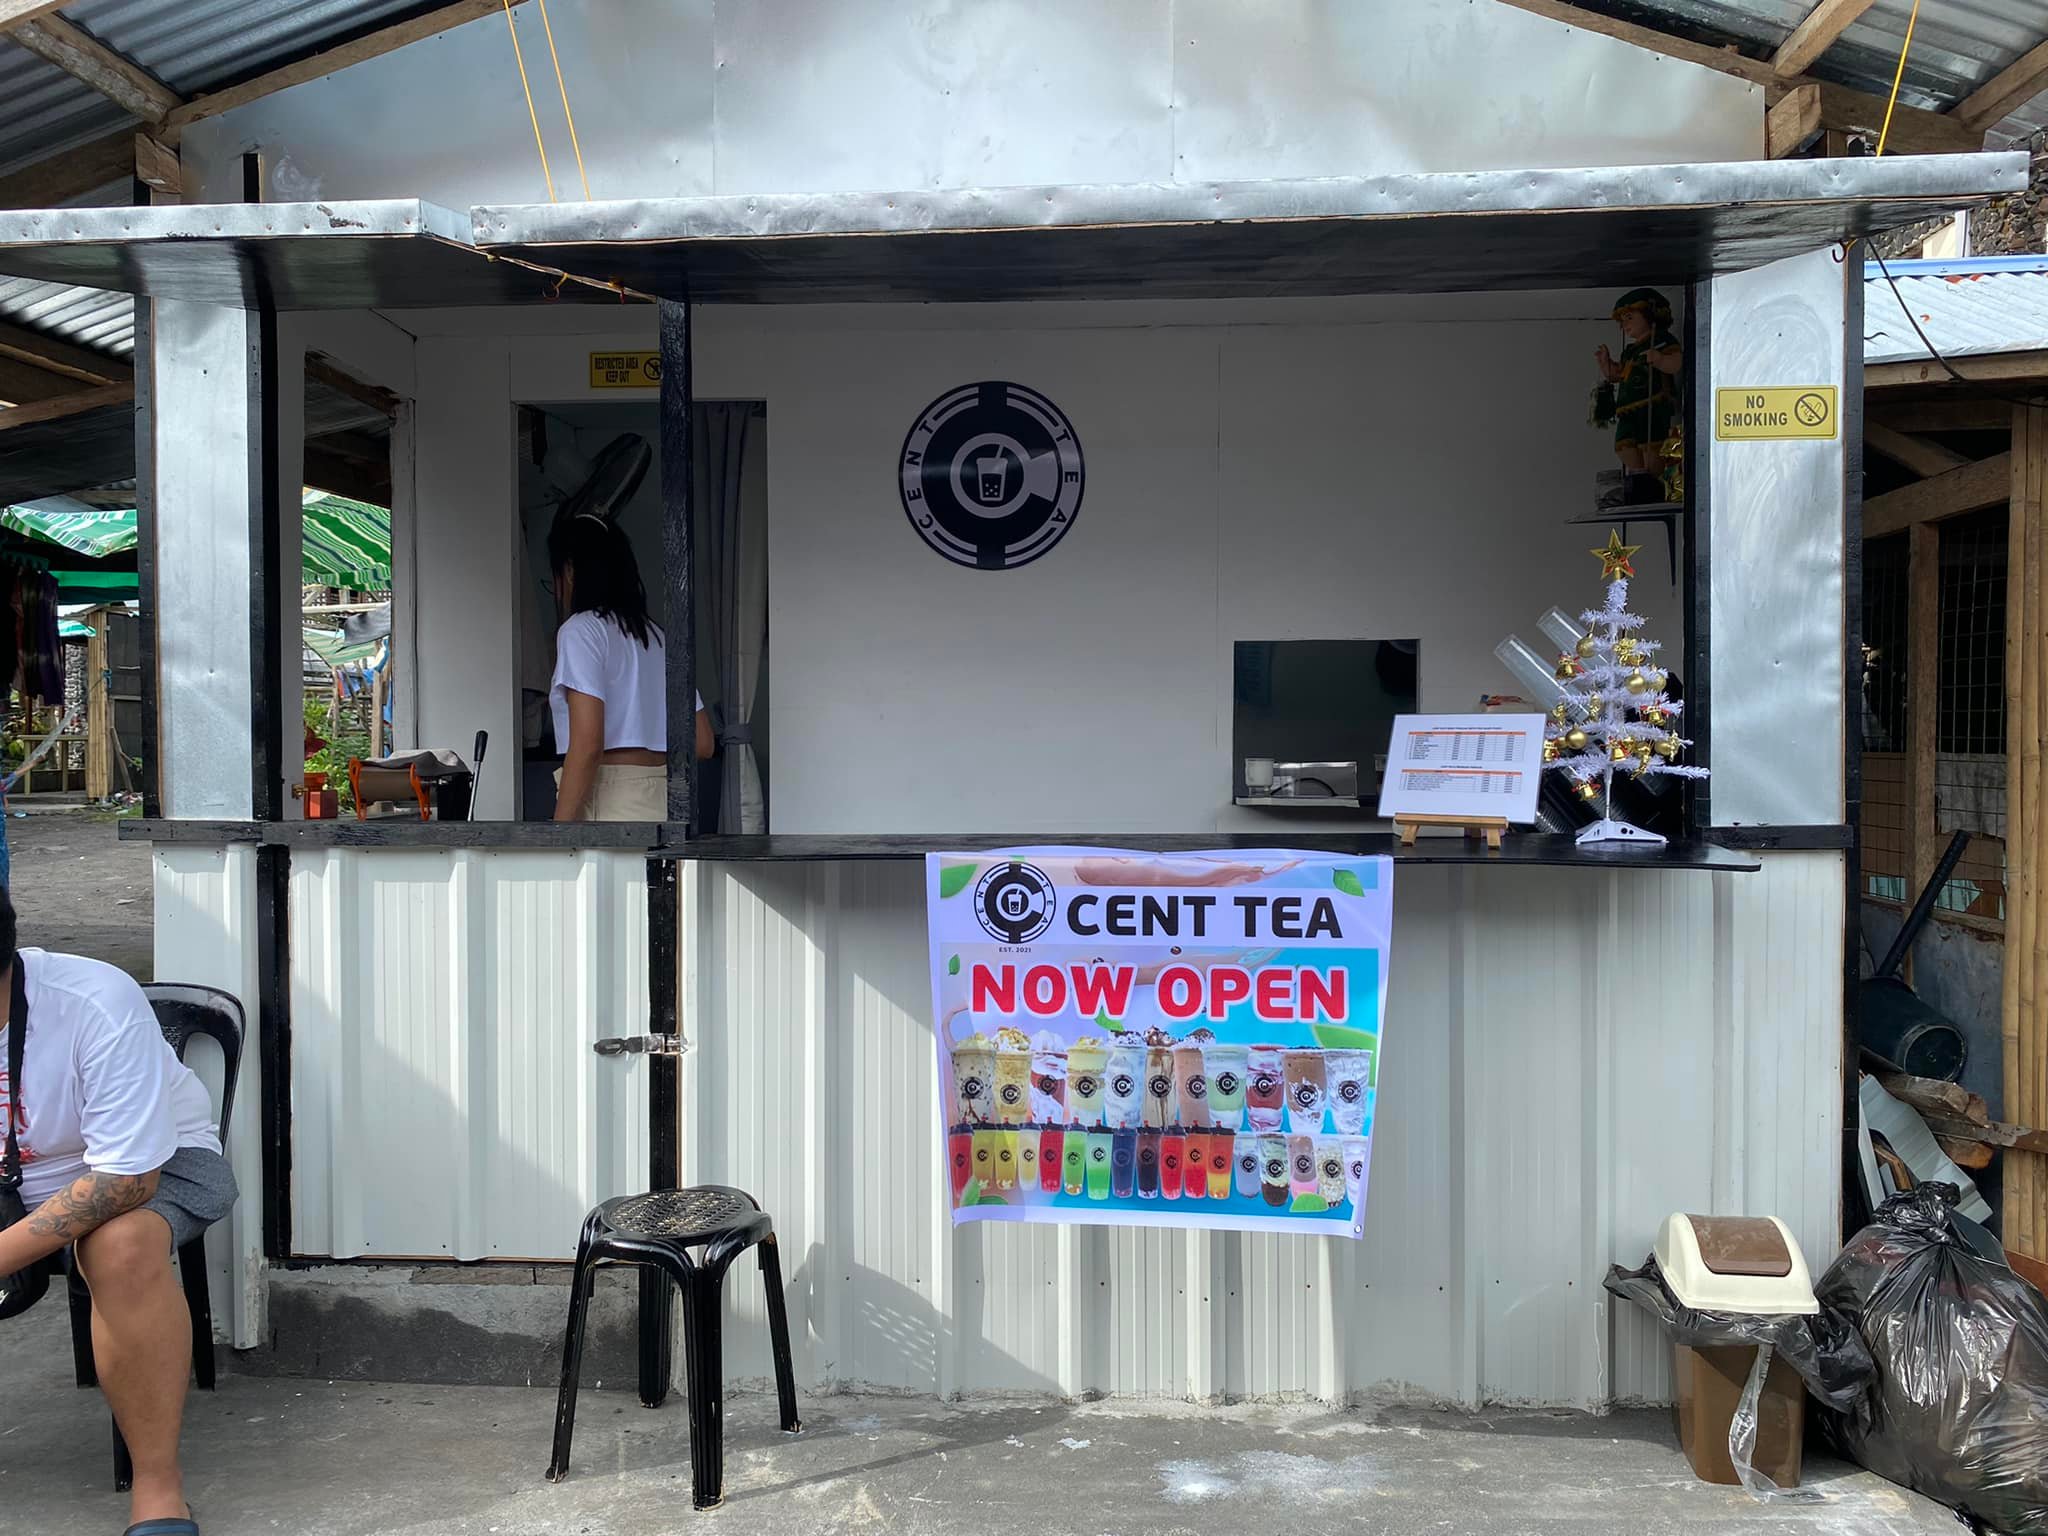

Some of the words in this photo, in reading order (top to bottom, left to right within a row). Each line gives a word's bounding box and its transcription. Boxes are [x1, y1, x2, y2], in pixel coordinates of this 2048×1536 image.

[606, 370, 618, 383] KEEP
[619, 370, 630, 383] OUT
[1746, 395, 1765, 409] NO
[1723, 412, 1788, 427] SMOKING
[906, 420, 934, 529] CENT
[1051, 429, 1079, 524] TEA
[1067, 894, 1216, 937] CENT
[1233, 896, 1344, 939] TEA
[971, 964, 1136, 1015] NOW
[1157, 967, 1346, 1019] OPEN
